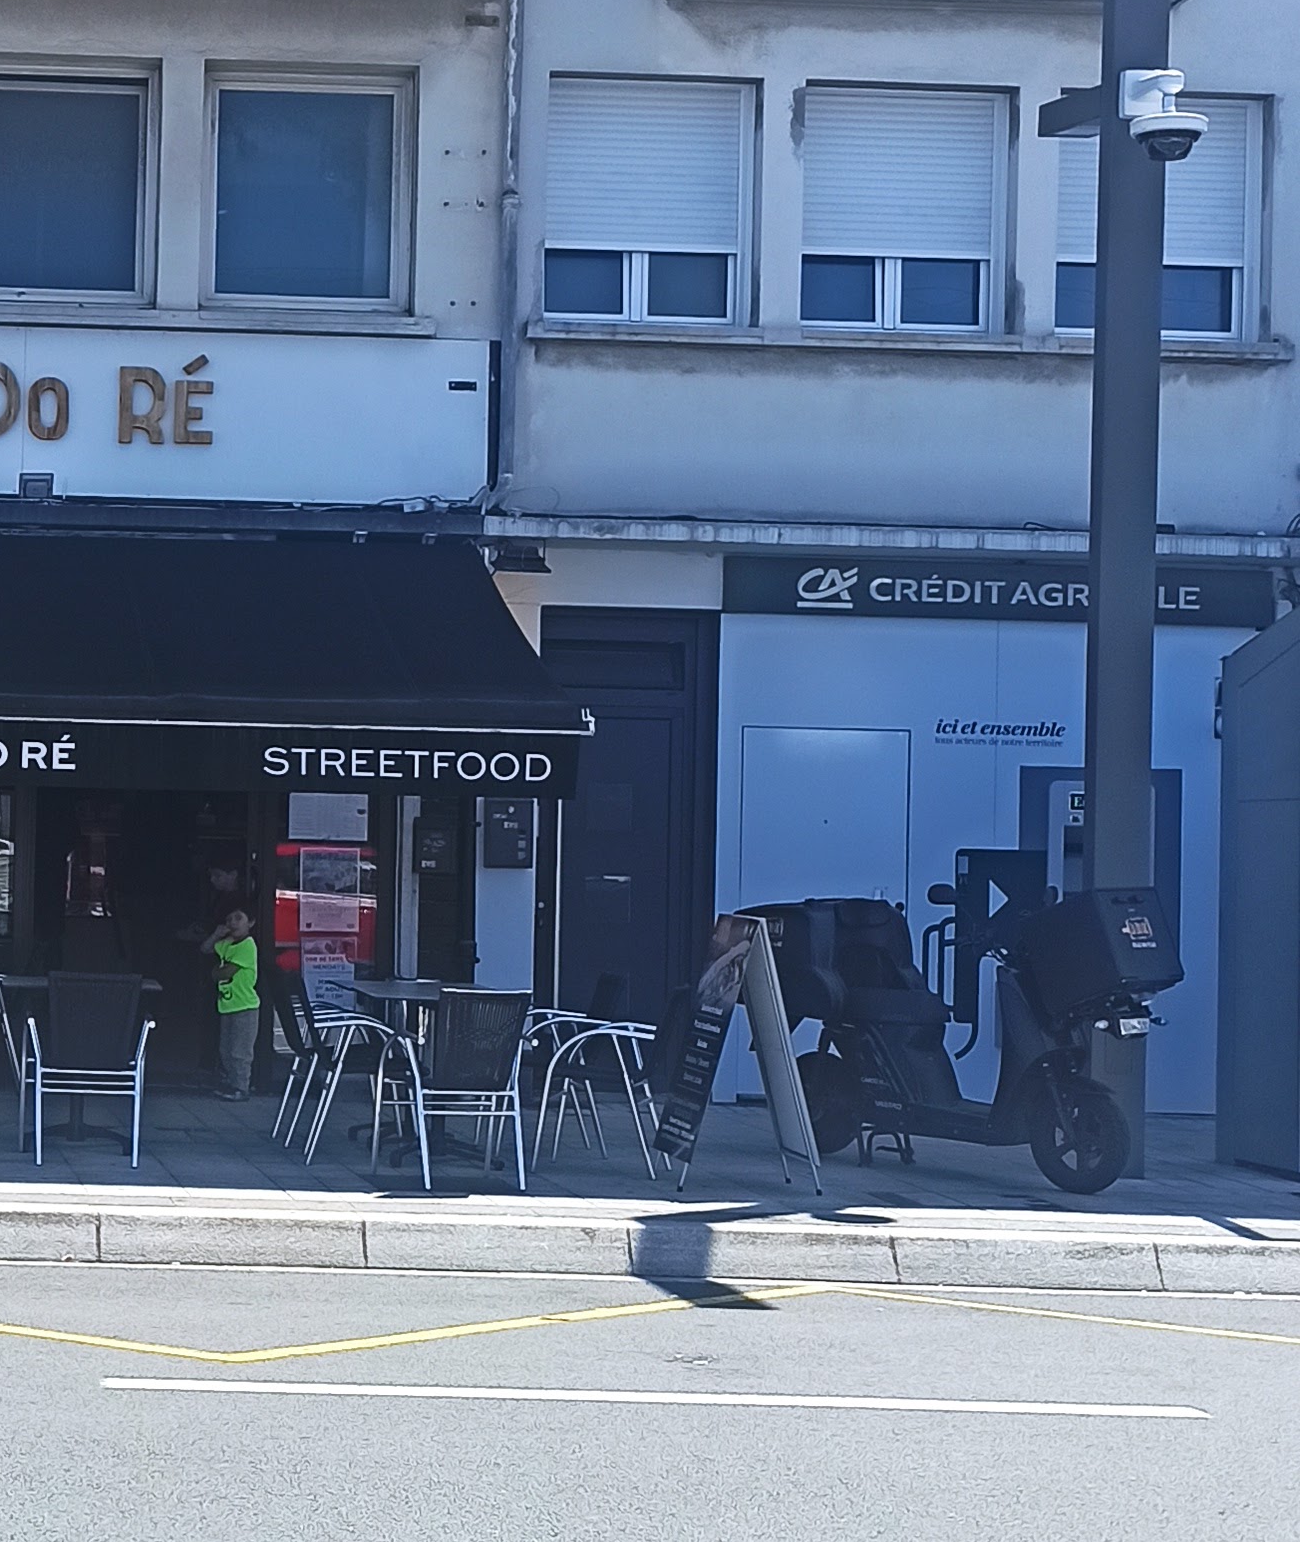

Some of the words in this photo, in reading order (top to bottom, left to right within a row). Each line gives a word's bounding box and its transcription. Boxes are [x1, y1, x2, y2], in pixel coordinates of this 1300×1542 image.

[118, 354, 214, 445] RÉ
[869, 574, 1005, 605] CRÉDIT
[1010, 581, 1201, 611] AGRLE
[935, 719, 959, 734] ici
[961, 721, 977, 734] et
[980, 721, 1066, 737] ensemble
[20, 735, 76, 771] RÉ
[263, 747, 552, 781] STREETFOOD
